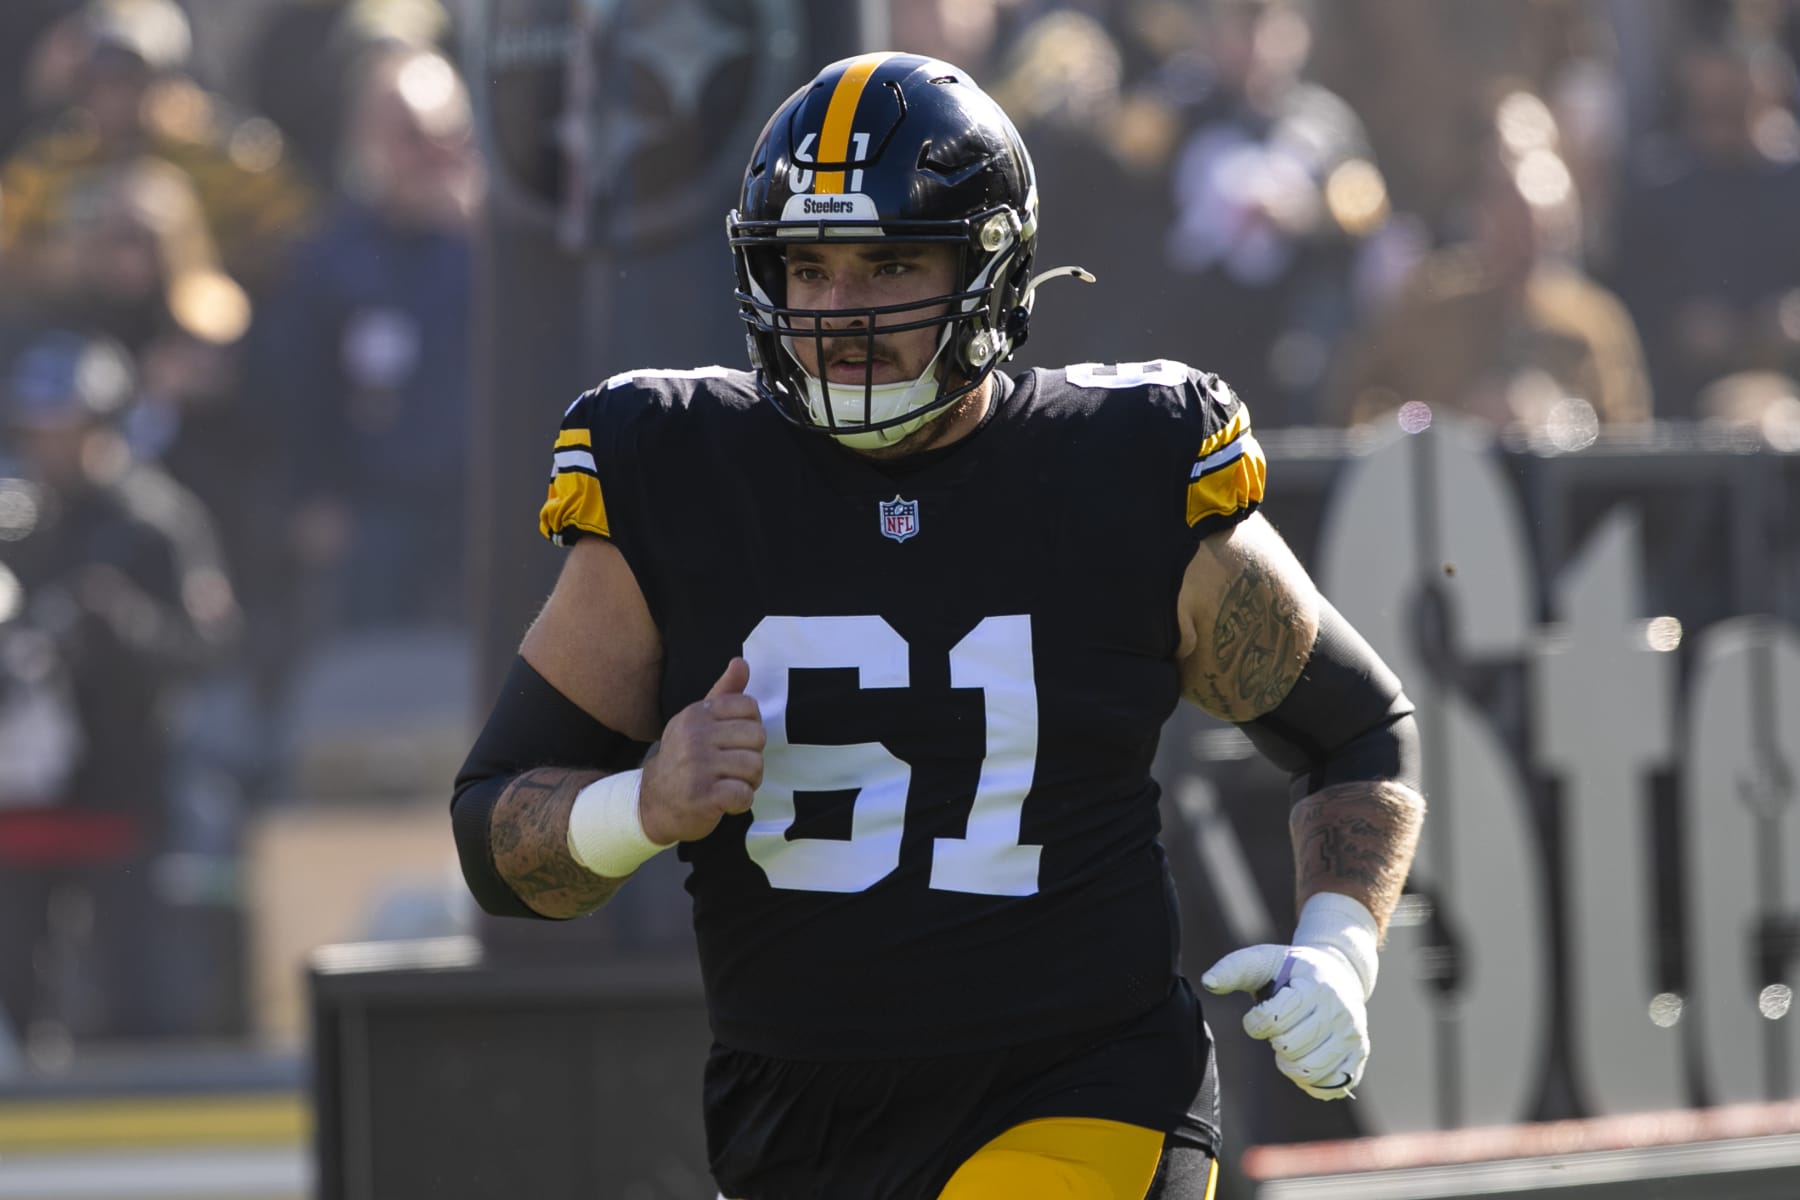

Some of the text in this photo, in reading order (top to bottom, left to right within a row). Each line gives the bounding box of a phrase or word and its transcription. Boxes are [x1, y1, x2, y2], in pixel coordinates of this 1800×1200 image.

[789, 132, 871, 193] 61
[803, 197, 853, 214] Steelers
[887, 516, 913, 533] NFL
[742, 613, 1044, 897] 61
